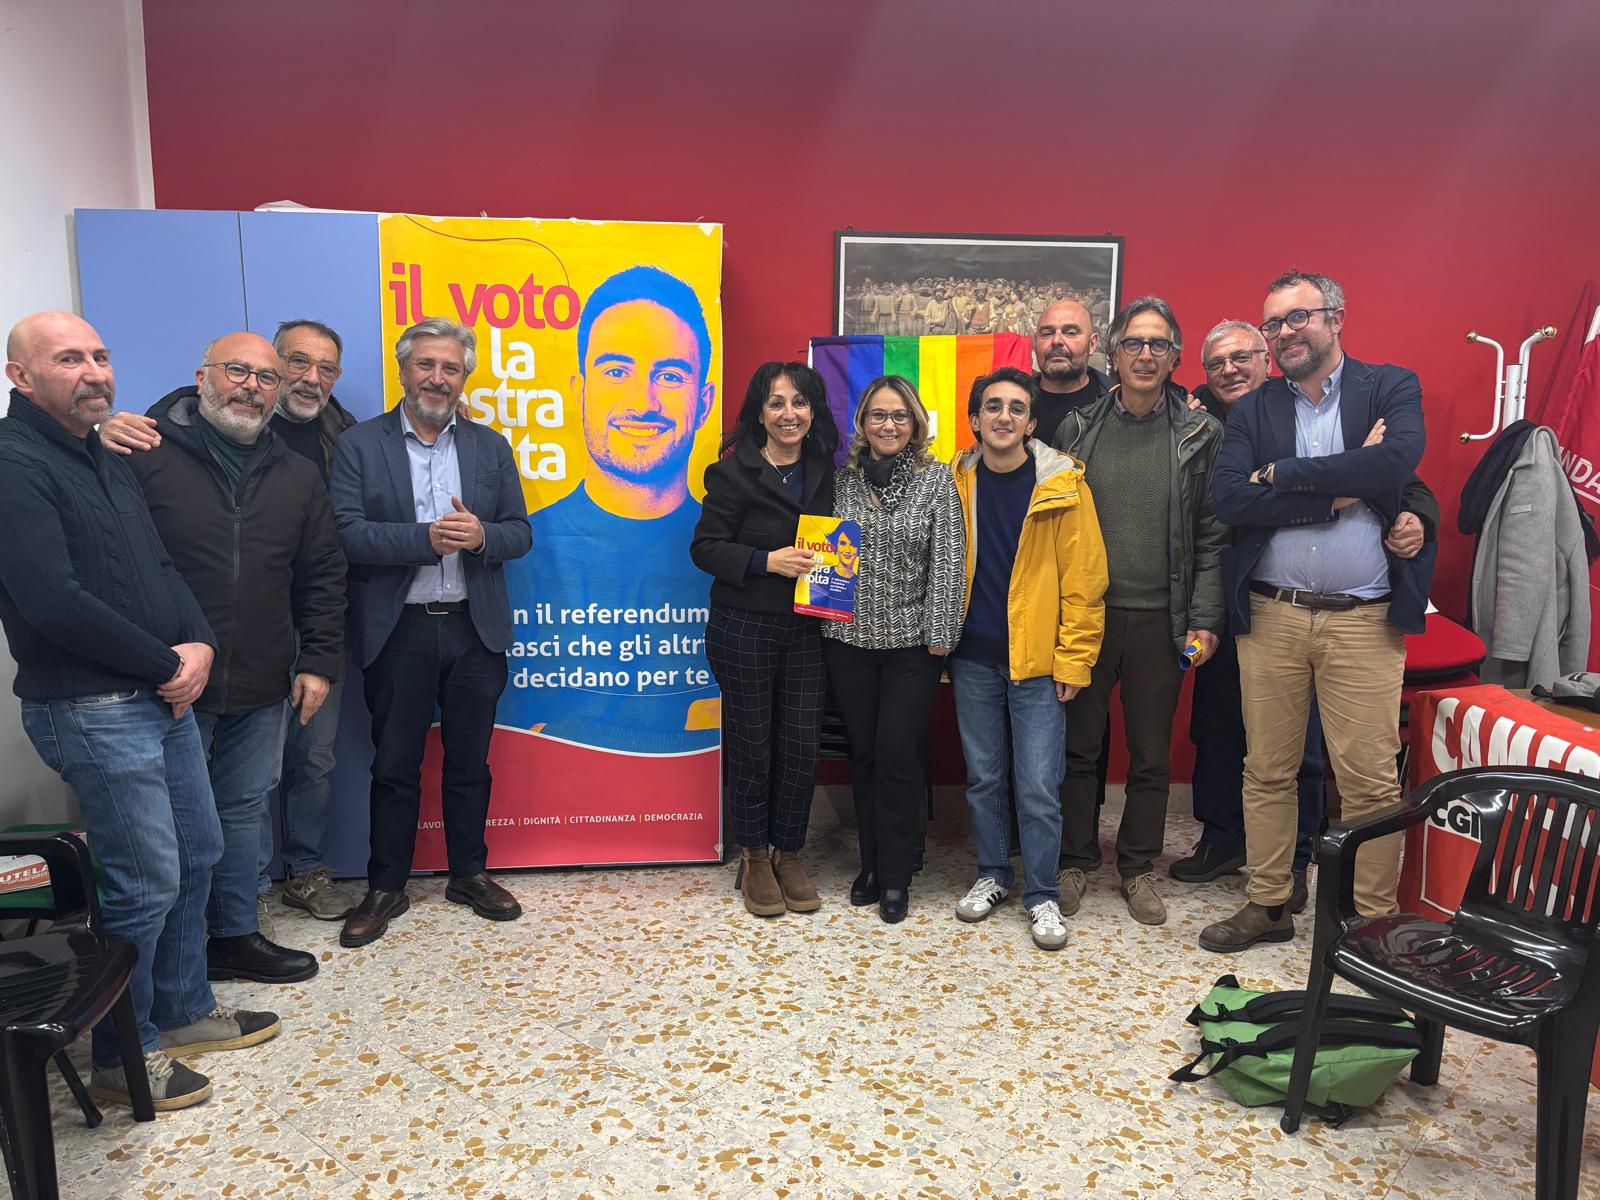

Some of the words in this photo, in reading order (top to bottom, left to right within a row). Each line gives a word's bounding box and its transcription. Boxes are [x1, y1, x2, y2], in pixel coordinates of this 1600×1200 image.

[389, 262, 430, 326] il
[448, 273, 581, 330] voto
[490, 327, 535, 380] la
[460, 379, 565, 427] stra
[797, 537, 805, 550] il
[807, 541, 835, 553] voto
[536, 603, 553, 625] il
[560, 603, 710, 625] referendum
[567, 635, 612, 657] che
[619, 634, 651, 661] gli
[513, 667, 630, 689] decidano
[637, 670, 679, 692] per
[685, 667, 710, 685] te
[485, 818, 516, 827] REZZA
[523, 816, 561, 826] DIGNITÀ
[569, 814, 637, 825] CITTADINANZA
[644, 812, 704, 823] DEMOCRAZIA
[1430, 804, 1480, 840] CGI
[0, 864, 49, 882] UTELA
